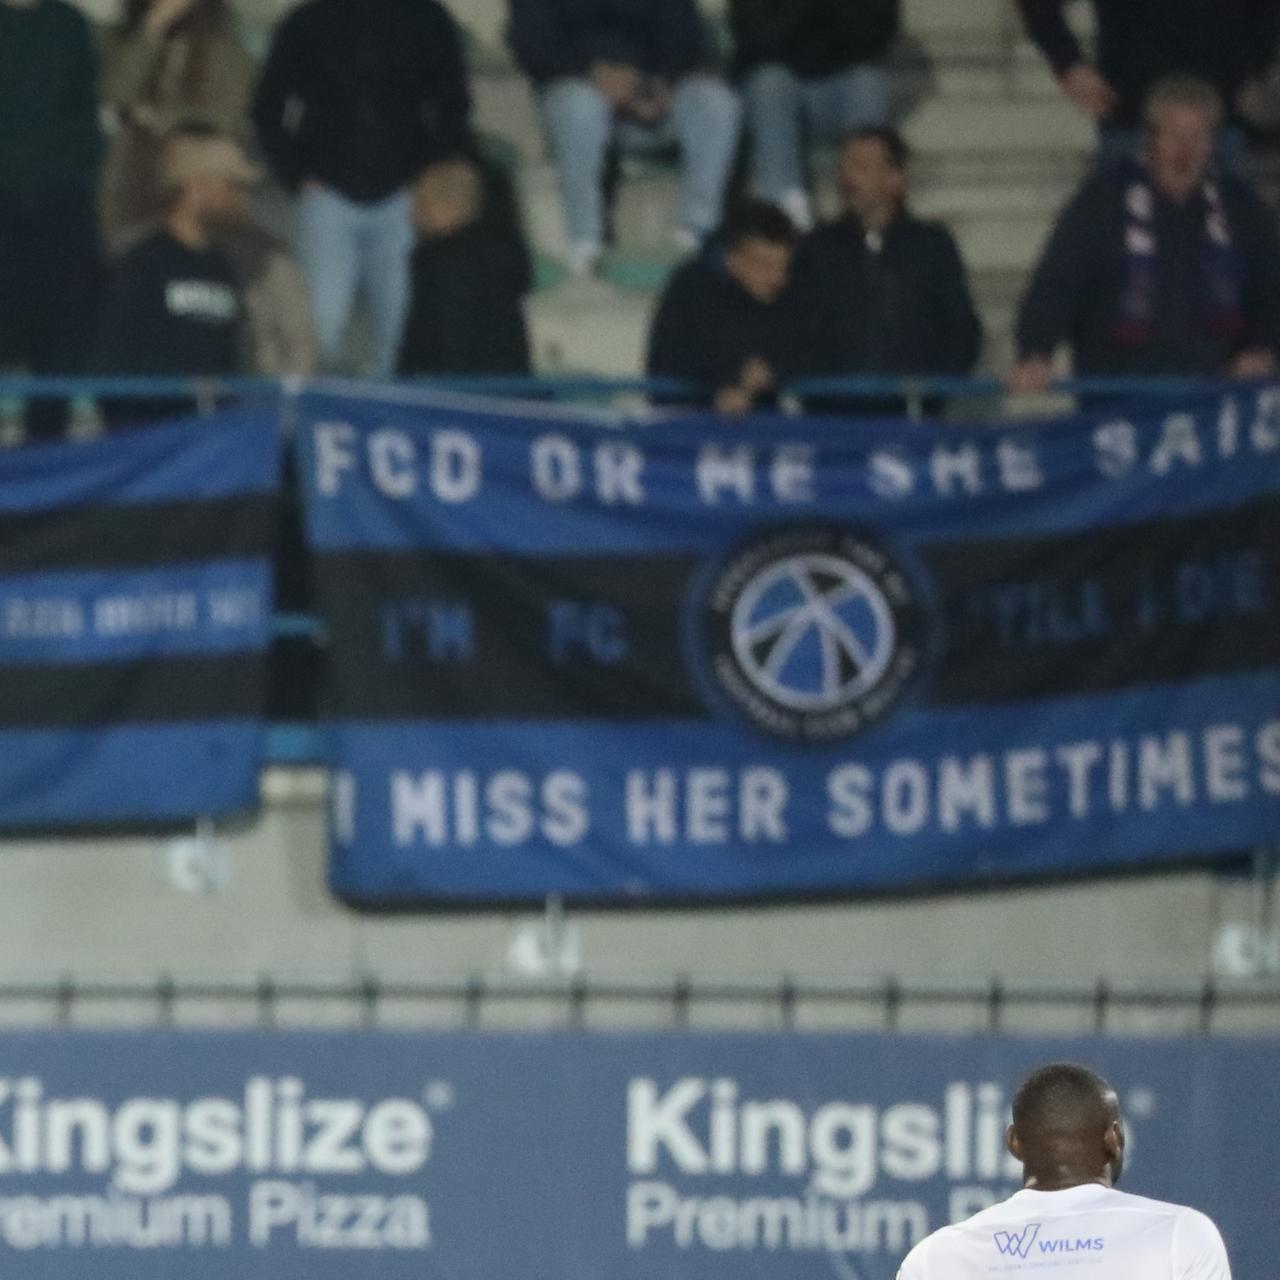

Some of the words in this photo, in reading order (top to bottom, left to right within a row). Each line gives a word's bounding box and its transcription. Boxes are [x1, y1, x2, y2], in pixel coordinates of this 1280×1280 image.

[312, 421, 482, 505] FCD
[531, 430, 647, 505] OR
[390, 769, 592, 850] MISS
[625, 766, 792, 845] HER
[827, 721, 1280, 840] SOMETIMES
[627, 1077, 1132, 1196] Kingsli
[247, 1181, 432, 1250] Pizza
[627, 1182, 928, 1250] Premium
[1039, 1238, 1104, 1253] WILMS
